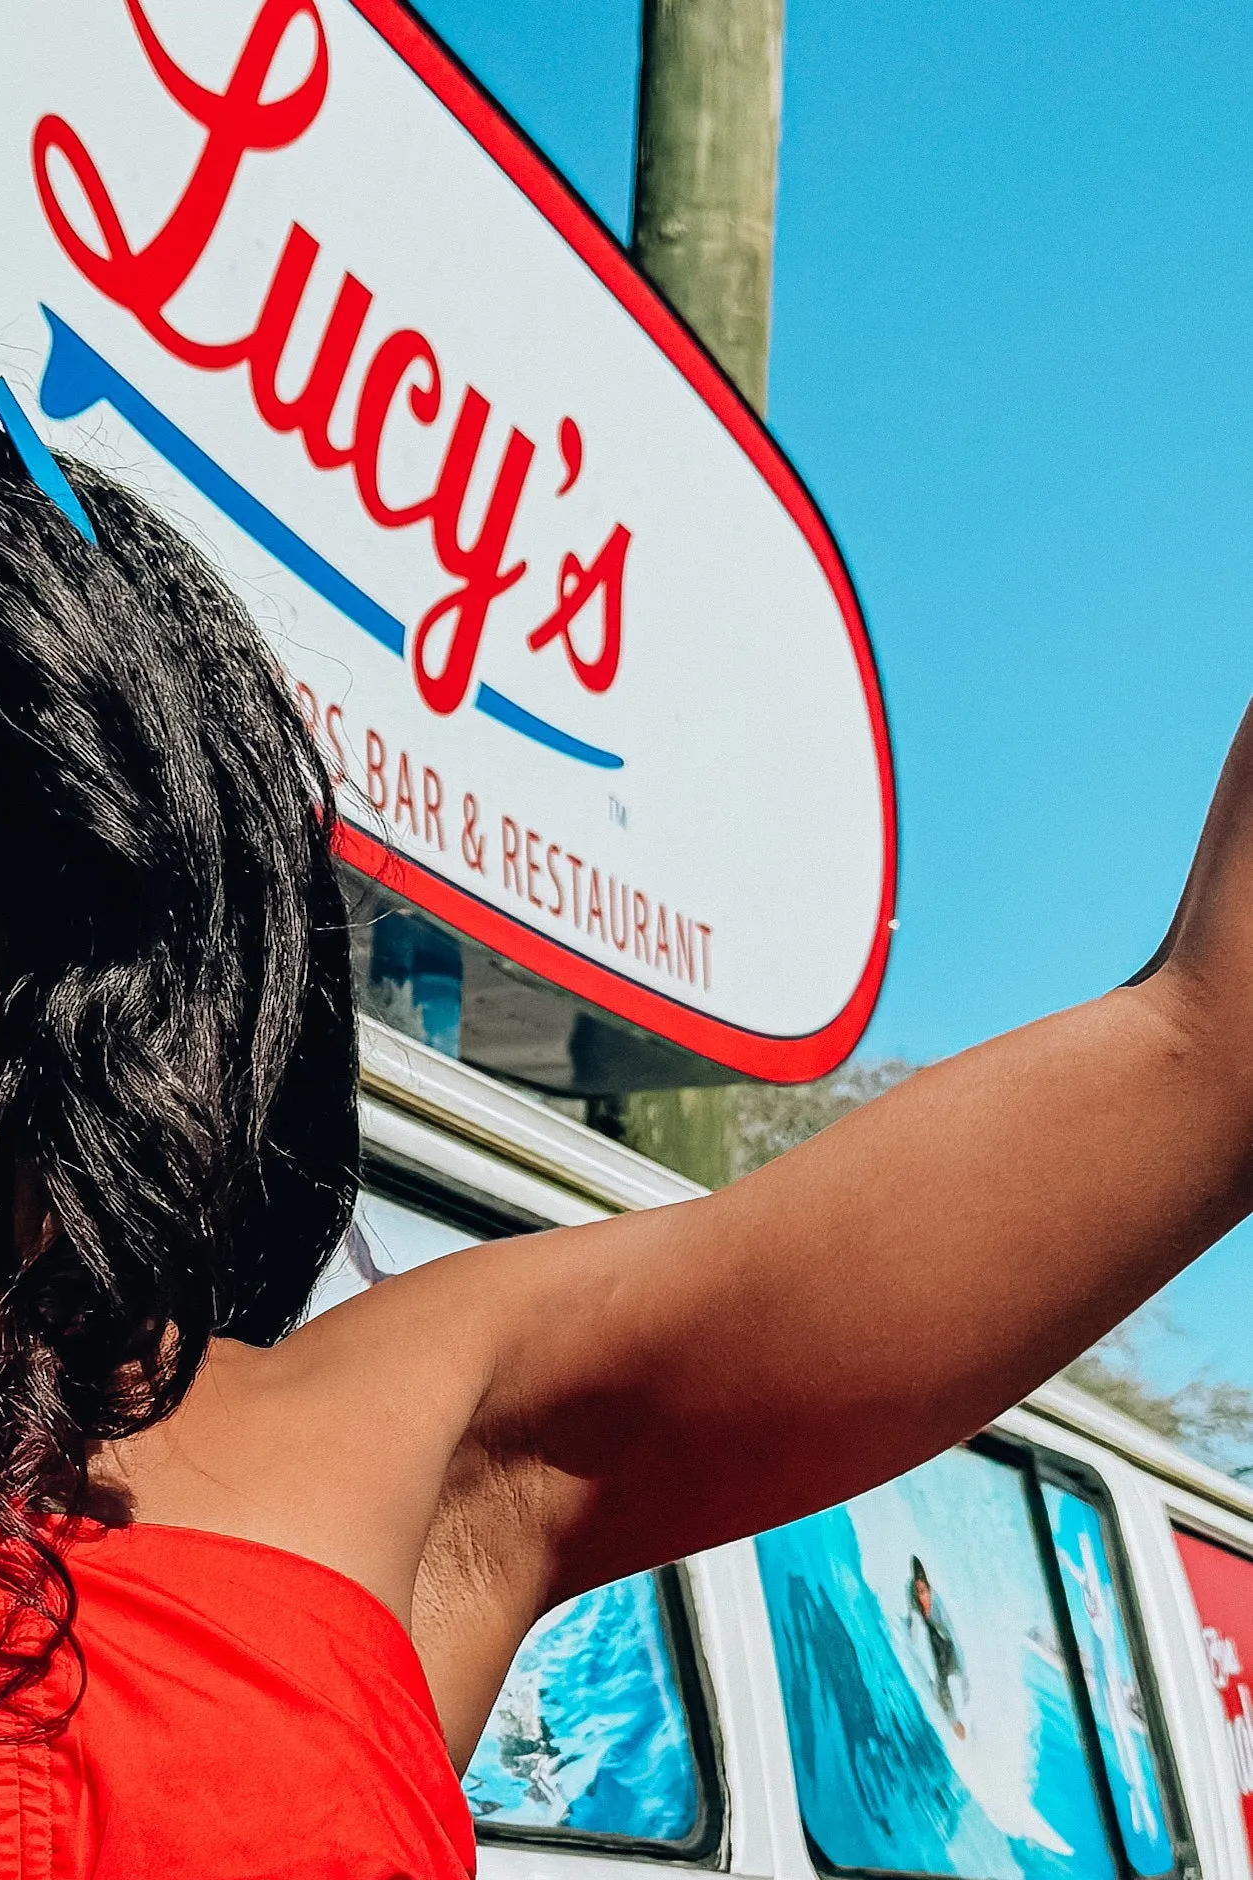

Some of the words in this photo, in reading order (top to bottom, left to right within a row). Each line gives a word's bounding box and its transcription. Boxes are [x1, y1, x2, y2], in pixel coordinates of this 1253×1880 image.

[31, 0, 632, 717] Lucy's
[366, 727, 444, 851] BAR
[461, 791, 487, 878] &
[501, 814, 713, 992] RESTAURANT
